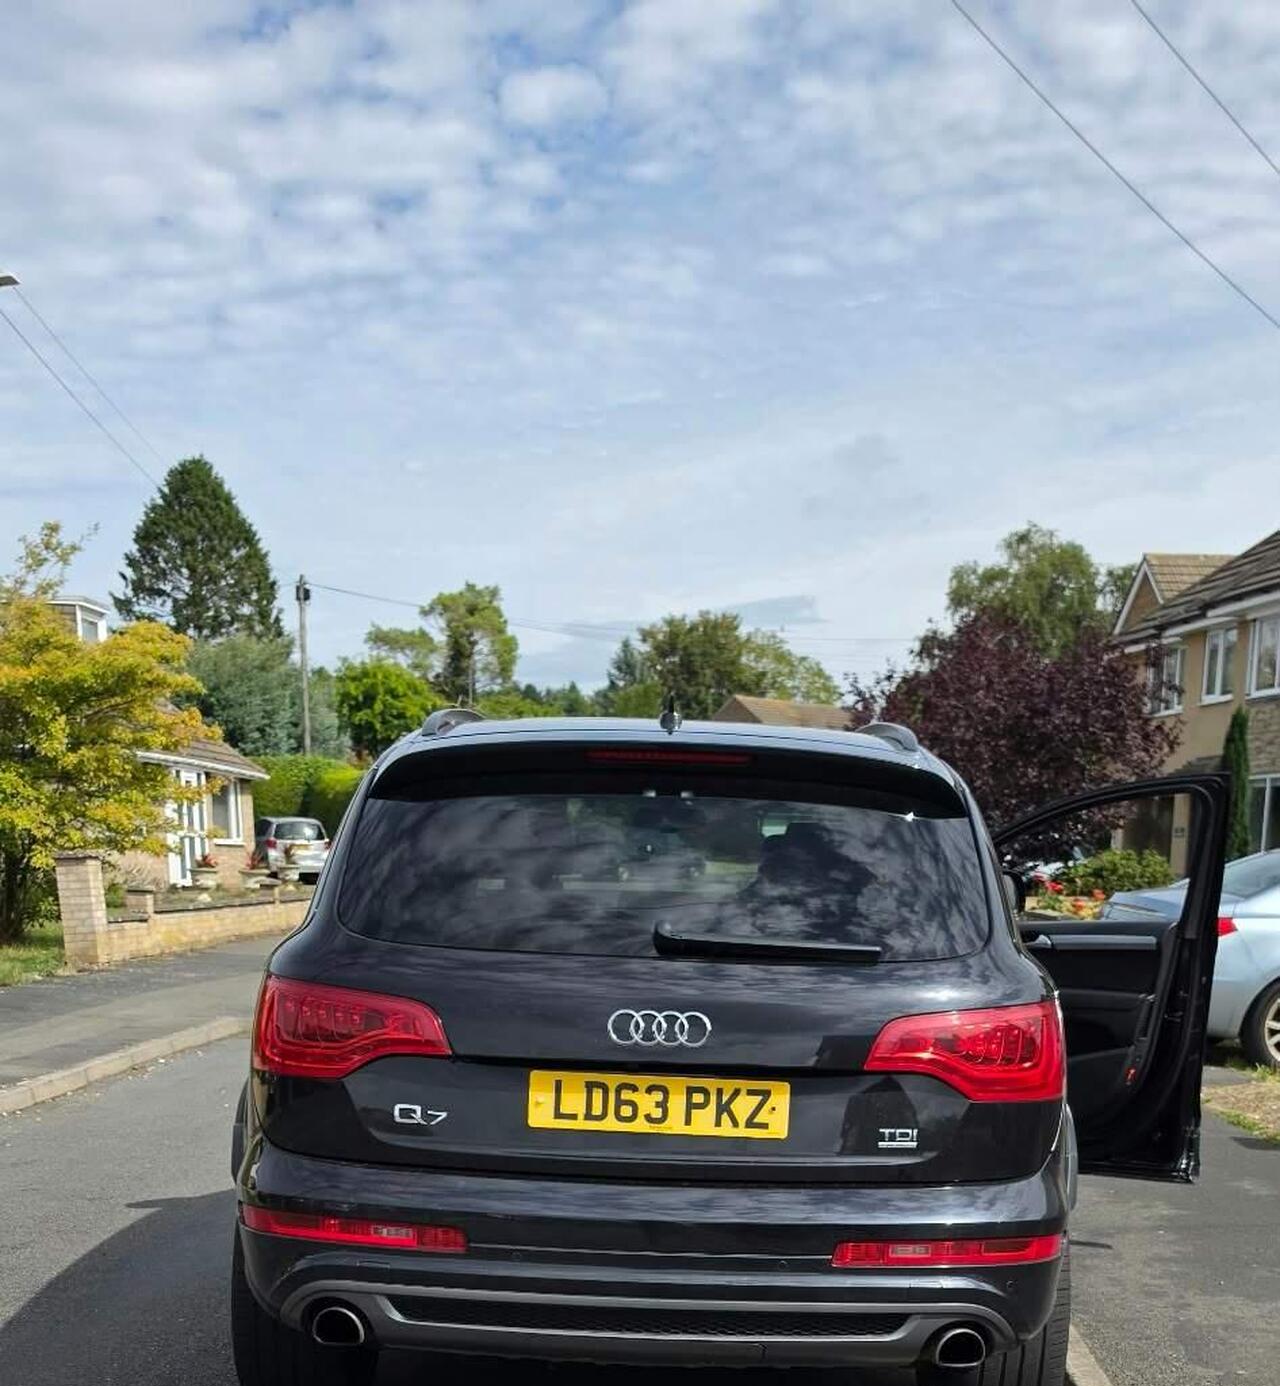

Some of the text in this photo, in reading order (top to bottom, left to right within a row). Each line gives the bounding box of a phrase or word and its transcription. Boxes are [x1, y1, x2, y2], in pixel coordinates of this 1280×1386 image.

[393, 1103, 448, 1125] Q7
[553, 1079, 772, 1130] LD63 PKZ
[878, 1128, 919, 1142] TDI
